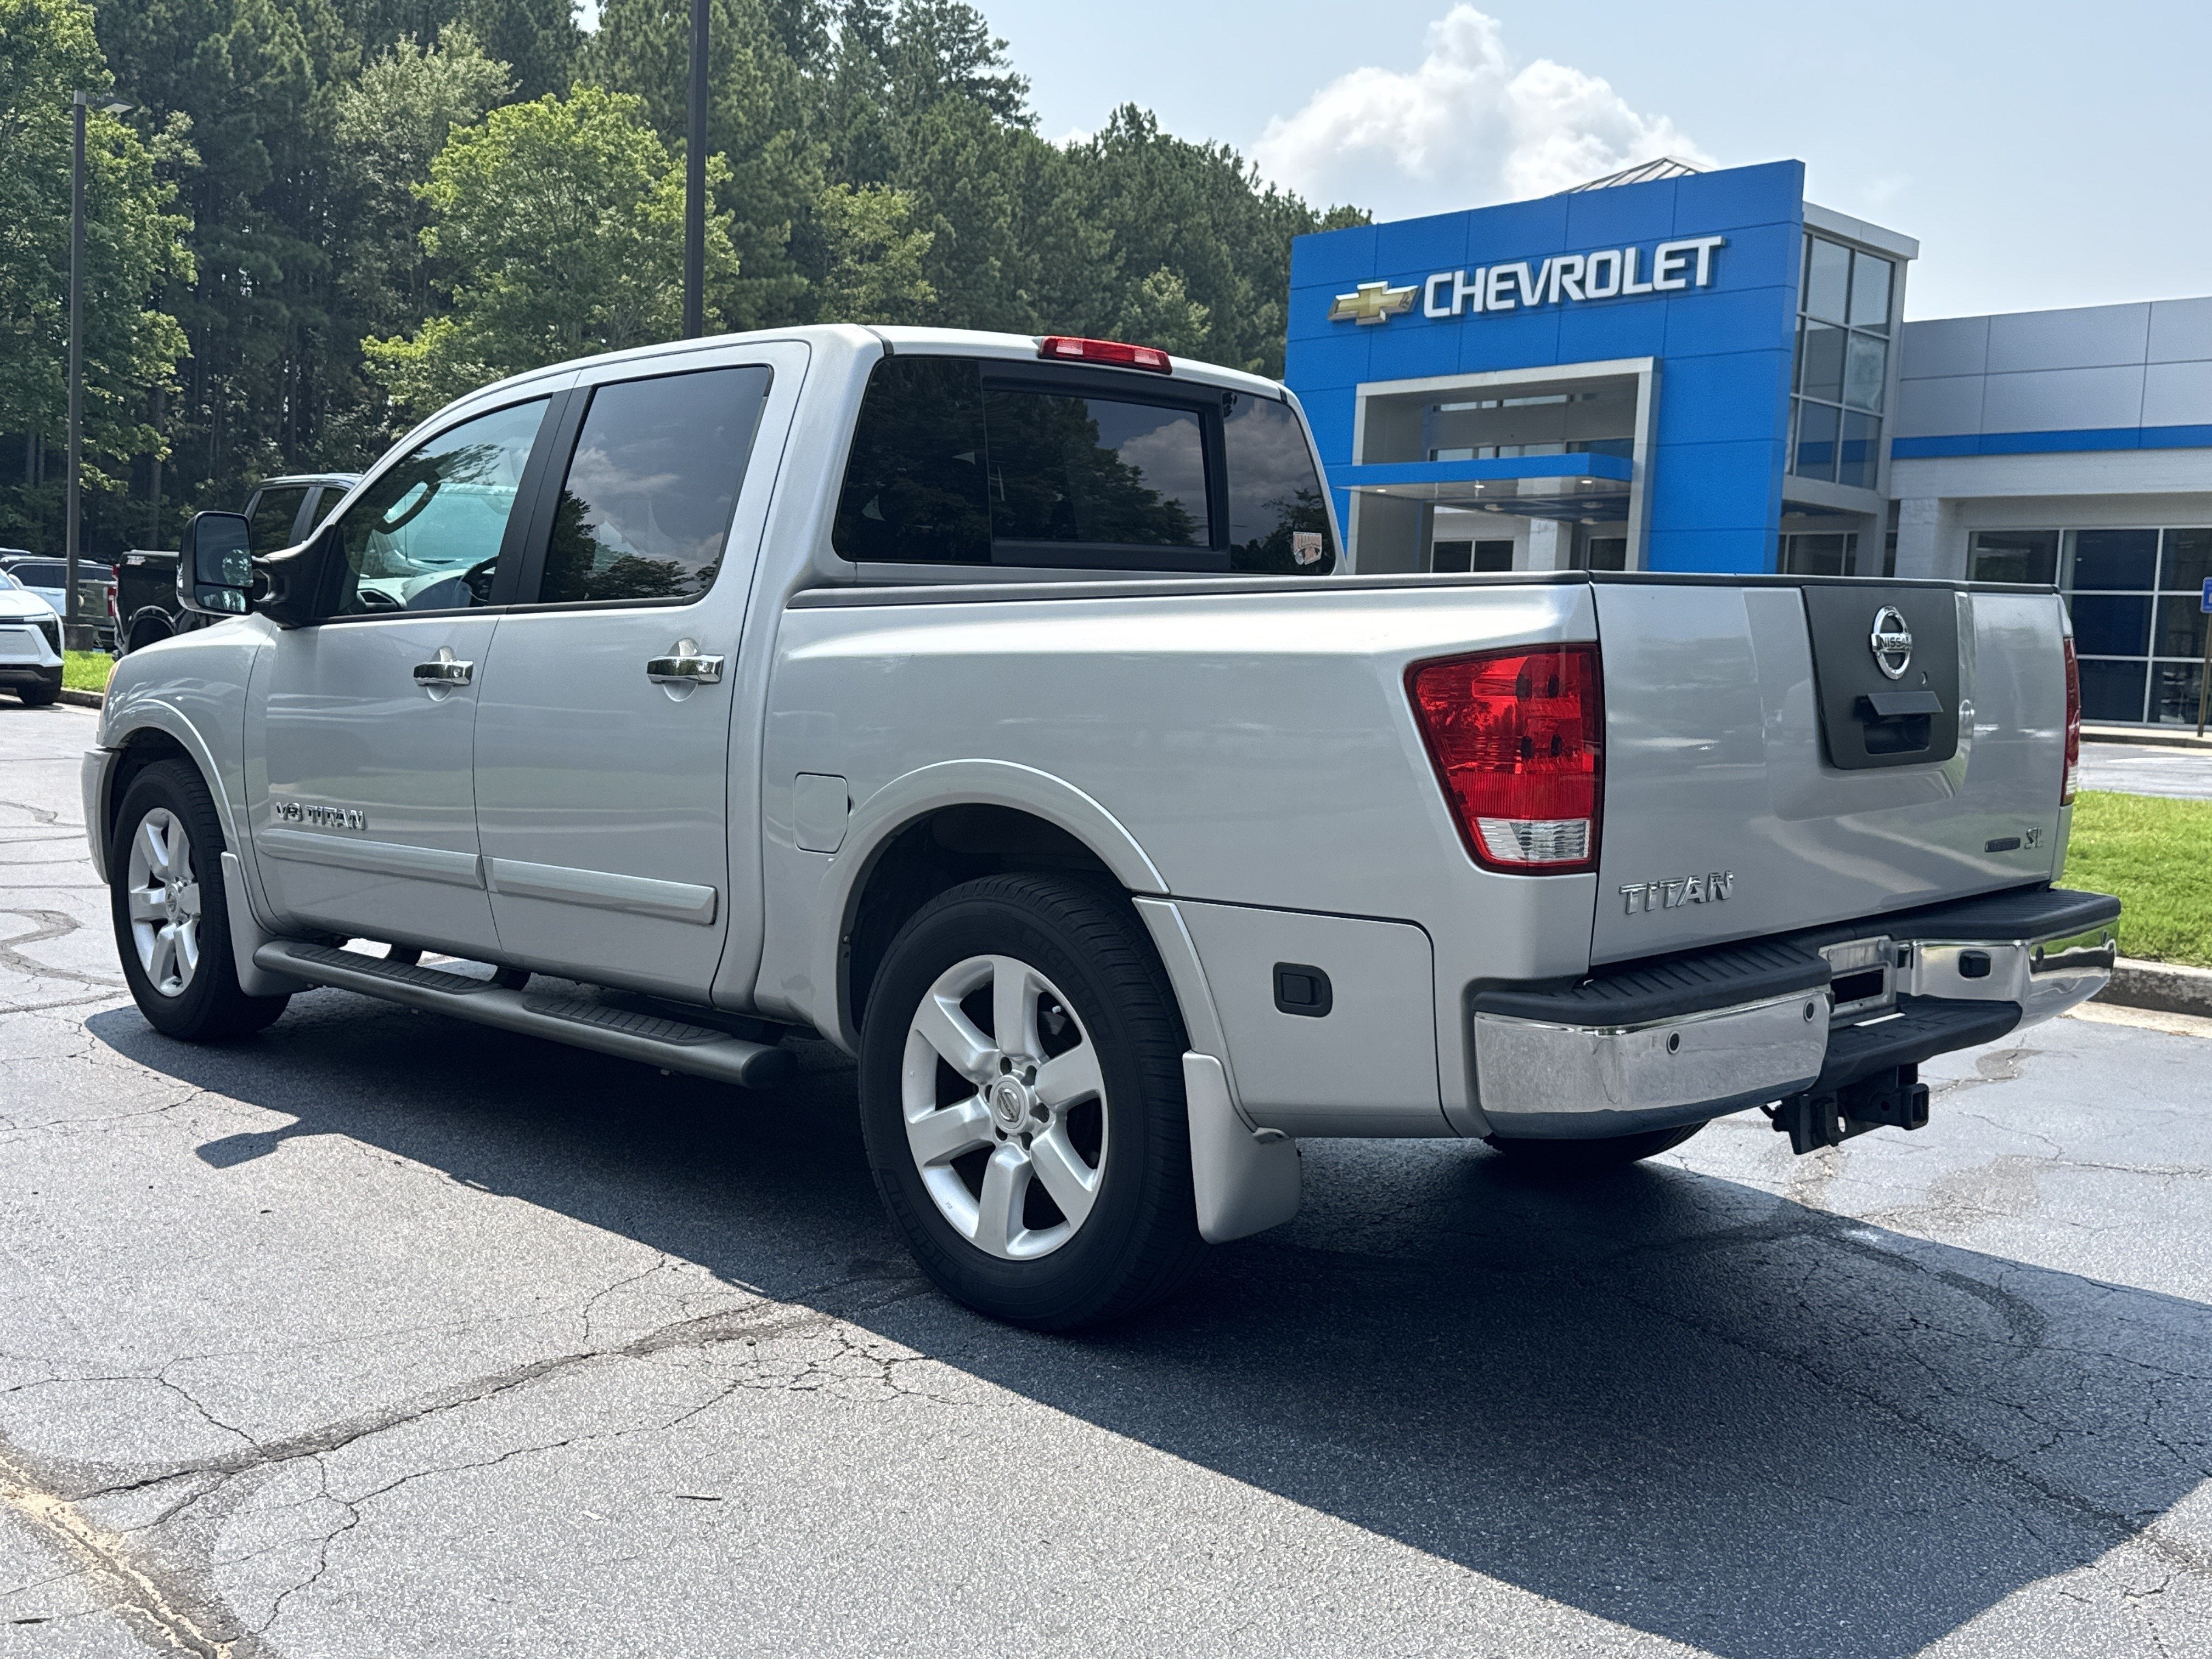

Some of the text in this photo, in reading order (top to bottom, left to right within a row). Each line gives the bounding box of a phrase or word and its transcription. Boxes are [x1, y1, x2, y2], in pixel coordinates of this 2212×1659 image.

[1424, 235, 1726, 318] CHEVROLET
[1877, 635, 1910, 648] NISSAN
[276, 802, 366, 831] V8 TITAN
[1619, 870, 1734, 915] TITAN
[1020, 927, 1111, 1035] MICHELIN
